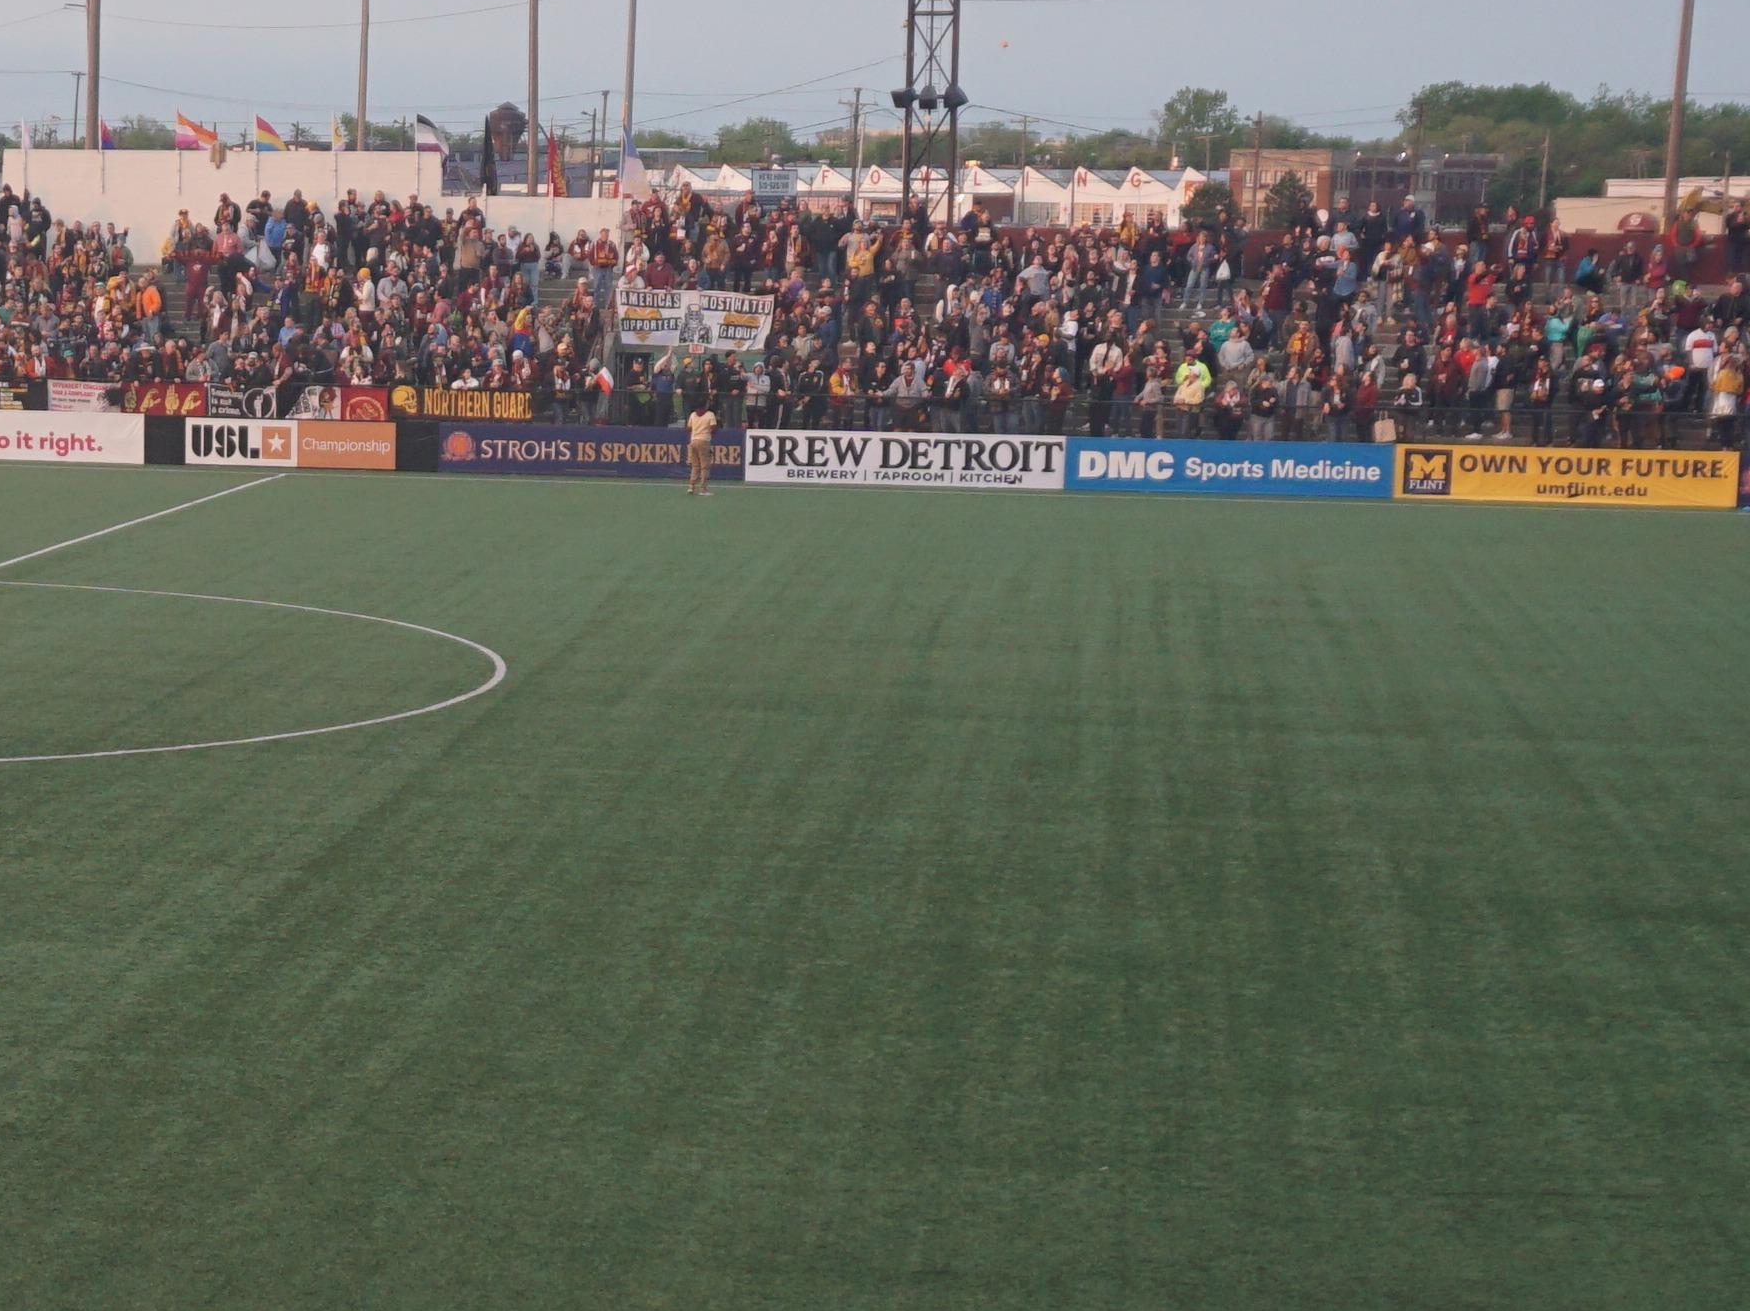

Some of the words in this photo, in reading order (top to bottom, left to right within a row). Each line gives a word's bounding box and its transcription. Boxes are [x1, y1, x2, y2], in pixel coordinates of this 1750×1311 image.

[620, 291, 681, 308] AMERICAS
[720, 325, 758, 339] GROUP
[423, 388, 492, 419] NORTHERN
[492, 390, 533, 420] GUARD
[16, 430, 34, 450] it
[39, 431, 104, 457] right.
[191, 423, 260, 459] USL
[302, 437, 391, 454] Championship
[480, 439, 571, 461] STROH'S
[577, 442, 596, 461] IS
[601, 443, 682, 464] SPOKEN
[749, 435, 872, 467] BREW
[879, 438, 1064, 473] DETROIT
[787, 469, 858, 480] BREWERY
[874, 470, 945, 482] TAPROOM
[959, 472, 1023, 485] KITCHEN
[1077, 450, 1175, 480] DMC
[1185, 456, 1265, 481] Sports
[1270, 458, 1382, 482] Medicine
[1409, 453, 1445, 480] M
[1458, 453, 1528, 474] OWN
[1536, 455, 1611, 477] YOUR
[1621, 457, 1729, 479] FUTURE.
[1408, 479, 1445, 491] FLINT
[1536, 481, 1648, 498] umflint.edu
